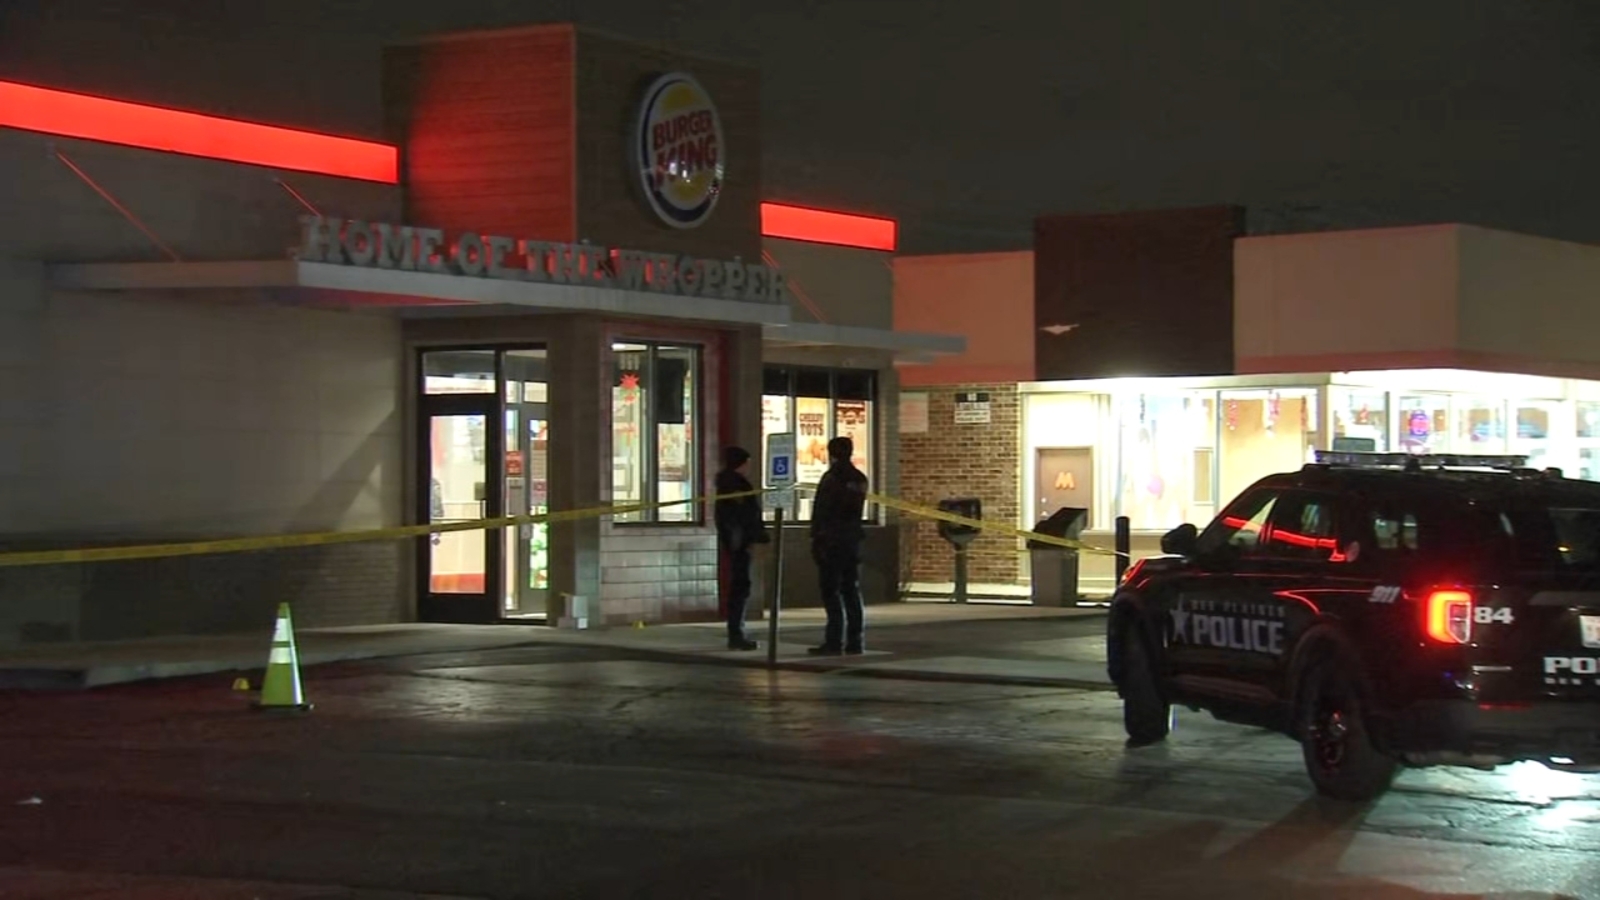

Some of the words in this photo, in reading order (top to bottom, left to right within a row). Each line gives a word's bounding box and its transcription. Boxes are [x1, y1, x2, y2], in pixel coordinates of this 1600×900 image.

[653, 110, 713, 151] BURGER
[656, 134, 717, 187] KING
[300, 215, 444, 273] HOME
[457, 232, 514, 280] OF
[525, 238, 608, 289] THE
[617, 247, 786, 304] WHOPPER
[799, 423, 825, 436] TOTS
[1192, 614, 1285, 655] POLICE
[1474, 606, 1514, 624] 84
[1543, 656, 1600, 674] PO
